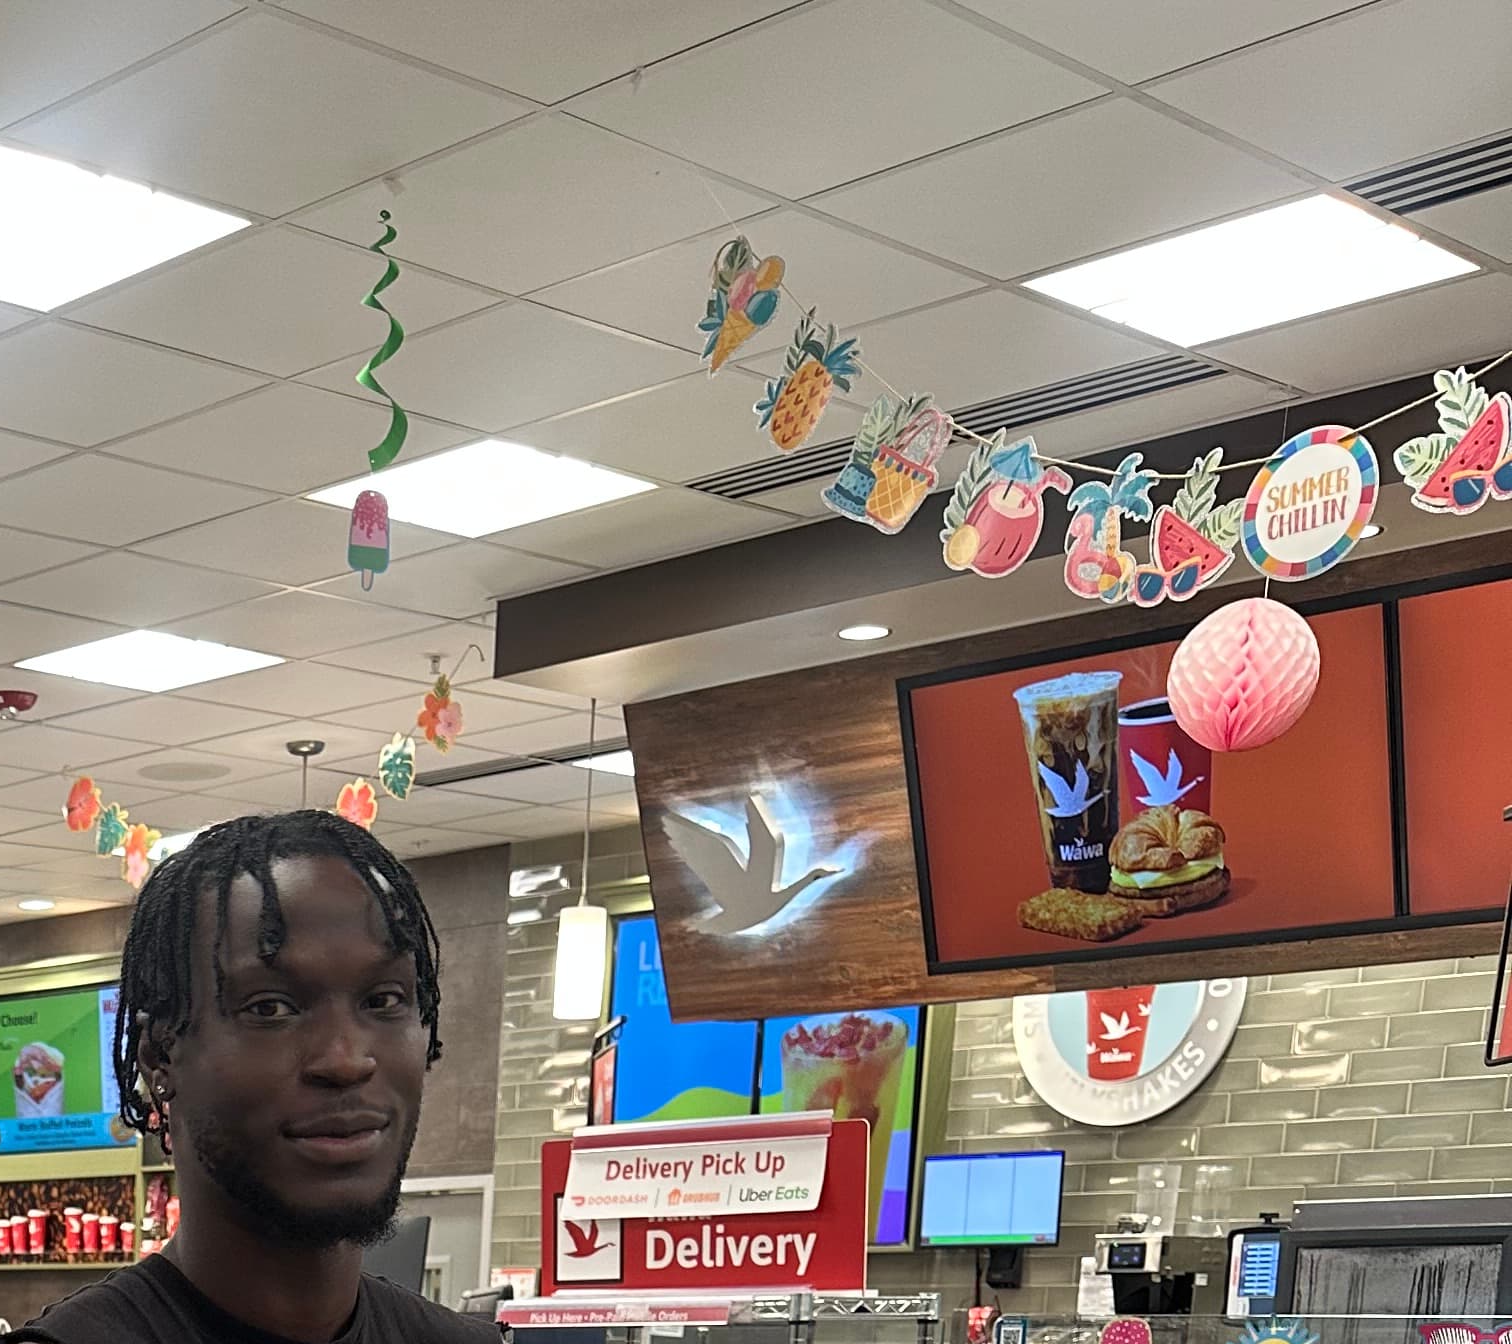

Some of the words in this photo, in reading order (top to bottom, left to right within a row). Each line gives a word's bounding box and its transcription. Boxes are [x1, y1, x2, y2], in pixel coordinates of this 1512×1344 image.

[1266, 466, 1349, 512] SUMMER
[1267, 495, 1347, 540] CHILLIN
[1059, 843, 1104, 861] Wawa
[605, 1157, 694, 1183] Delivery
[701, 1152, 746, 1176] Pick
[754, 1150, 786, 1178] Up
[738, 1186, 773, 1202] Uber
[774, 1185, 809, 1201] Eats
[645, 1224, 817, 1276] Delivery
